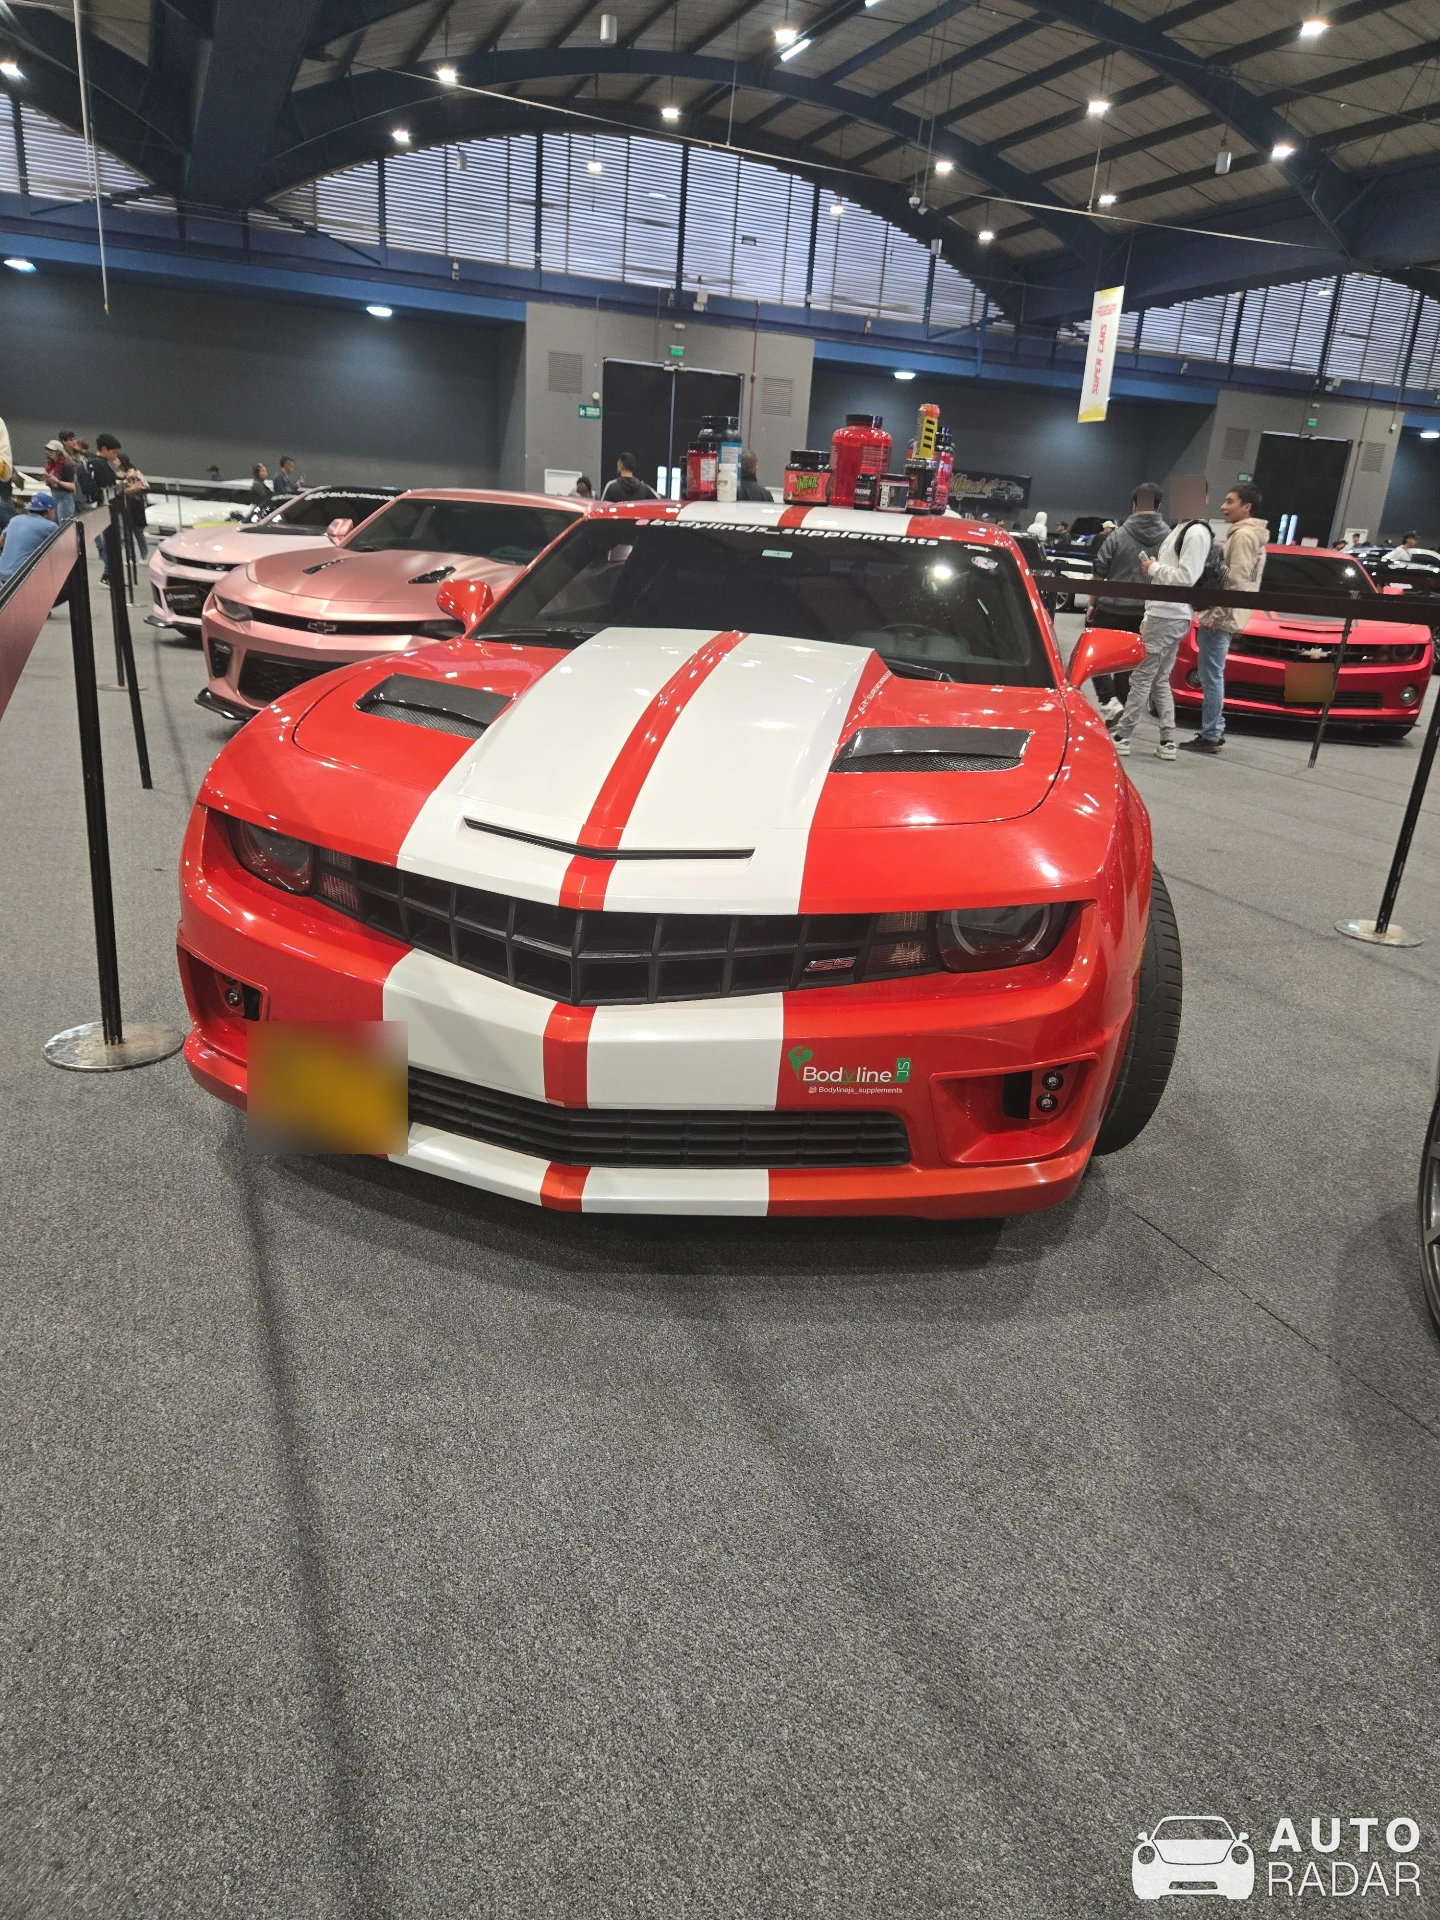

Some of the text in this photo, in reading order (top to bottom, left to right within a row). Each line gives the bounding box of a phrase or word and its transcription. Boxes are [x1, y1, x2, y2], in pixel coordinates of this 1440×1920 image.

[1091, 358, 1103, 395] SUPER
[1097, 323, 1107, 353] CARS
[650, 518, 939, 546] bodylinejs_supplements
[803, 1066, 892, 1084] Bodyline
[818, 1086, 903, 1095] Bodylinejs_supplements
